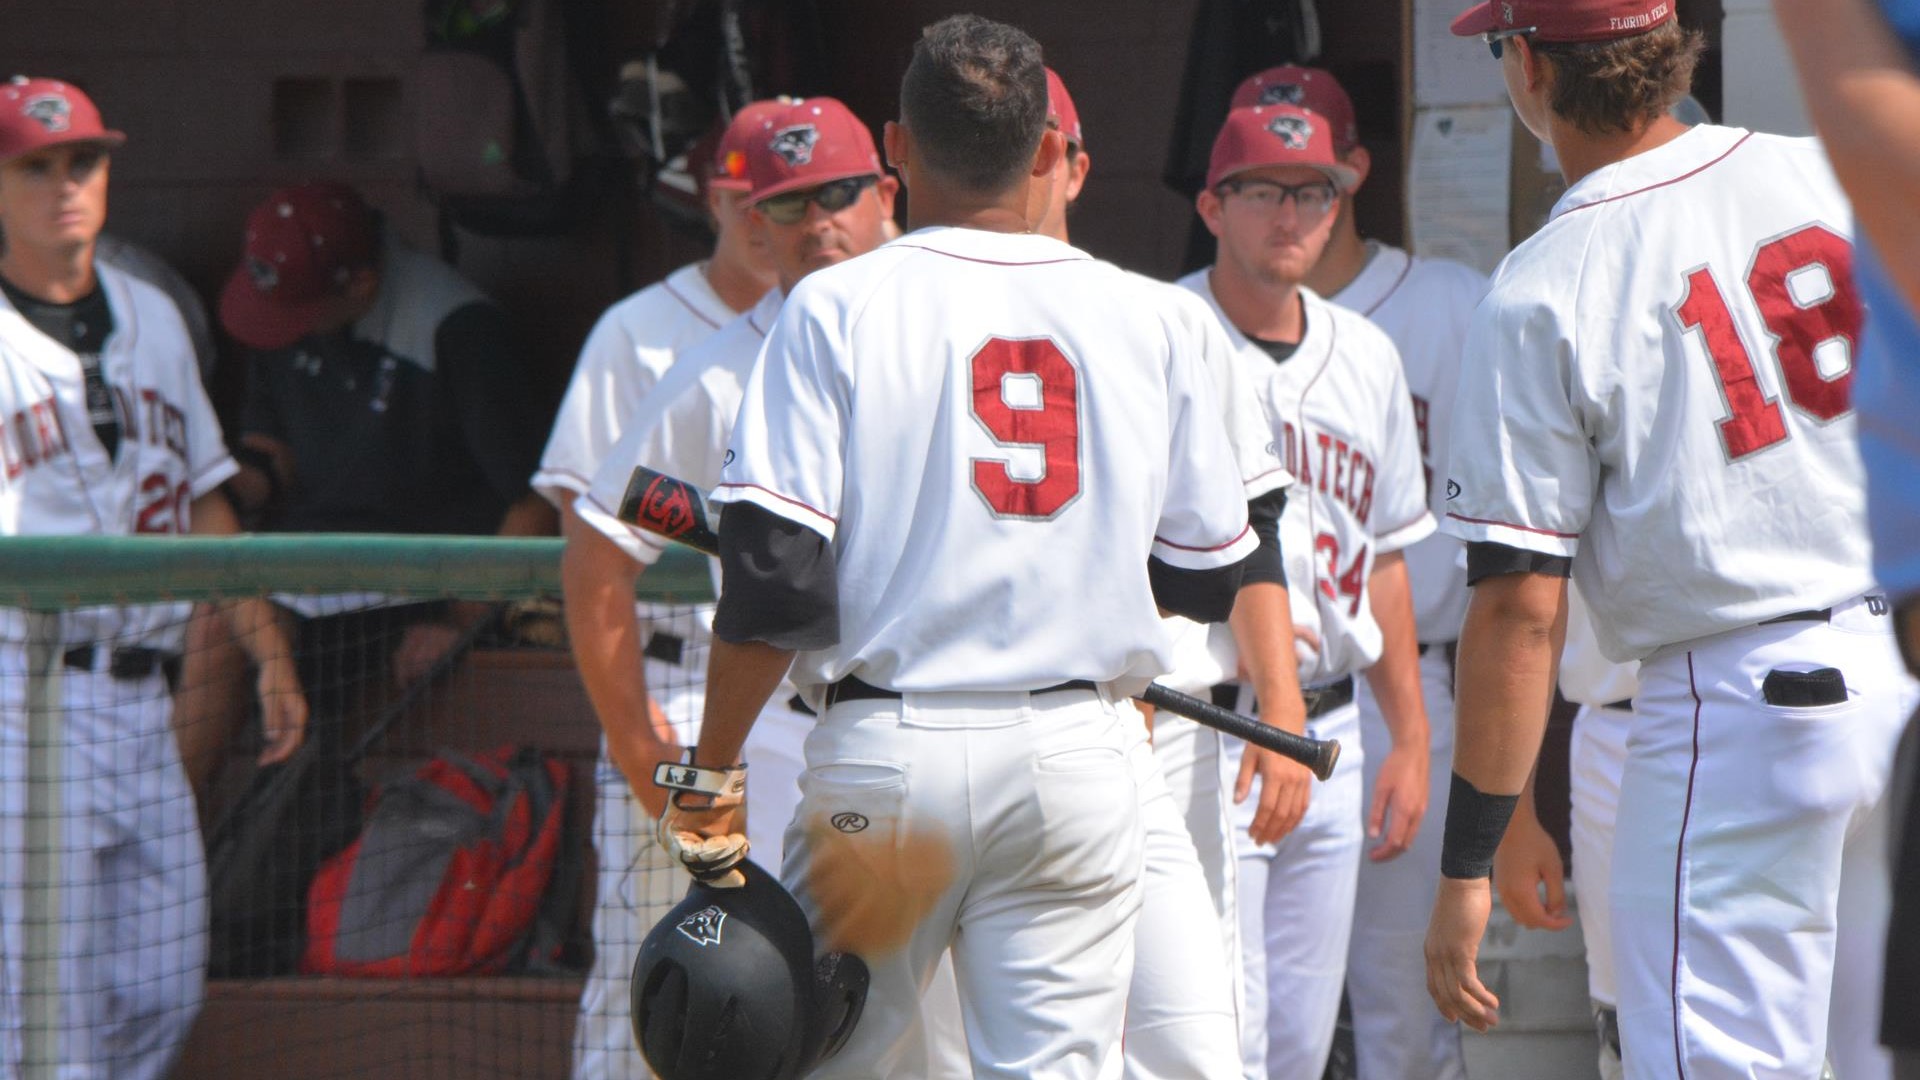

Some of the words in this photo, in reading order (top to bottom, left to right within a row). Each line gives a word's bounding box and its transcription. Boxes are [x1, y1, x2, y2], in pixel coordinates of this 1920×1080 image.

[1609, 13, 1651, 30] FLORIDA
[1651, 2, 1669, 21] TECH
[1669, 220, 1864, 464] 18
[965, 333, 1085, 523] 9
[1317, 432, 1375, 526] TECH
[1315, 531, 1367, 618] 34
